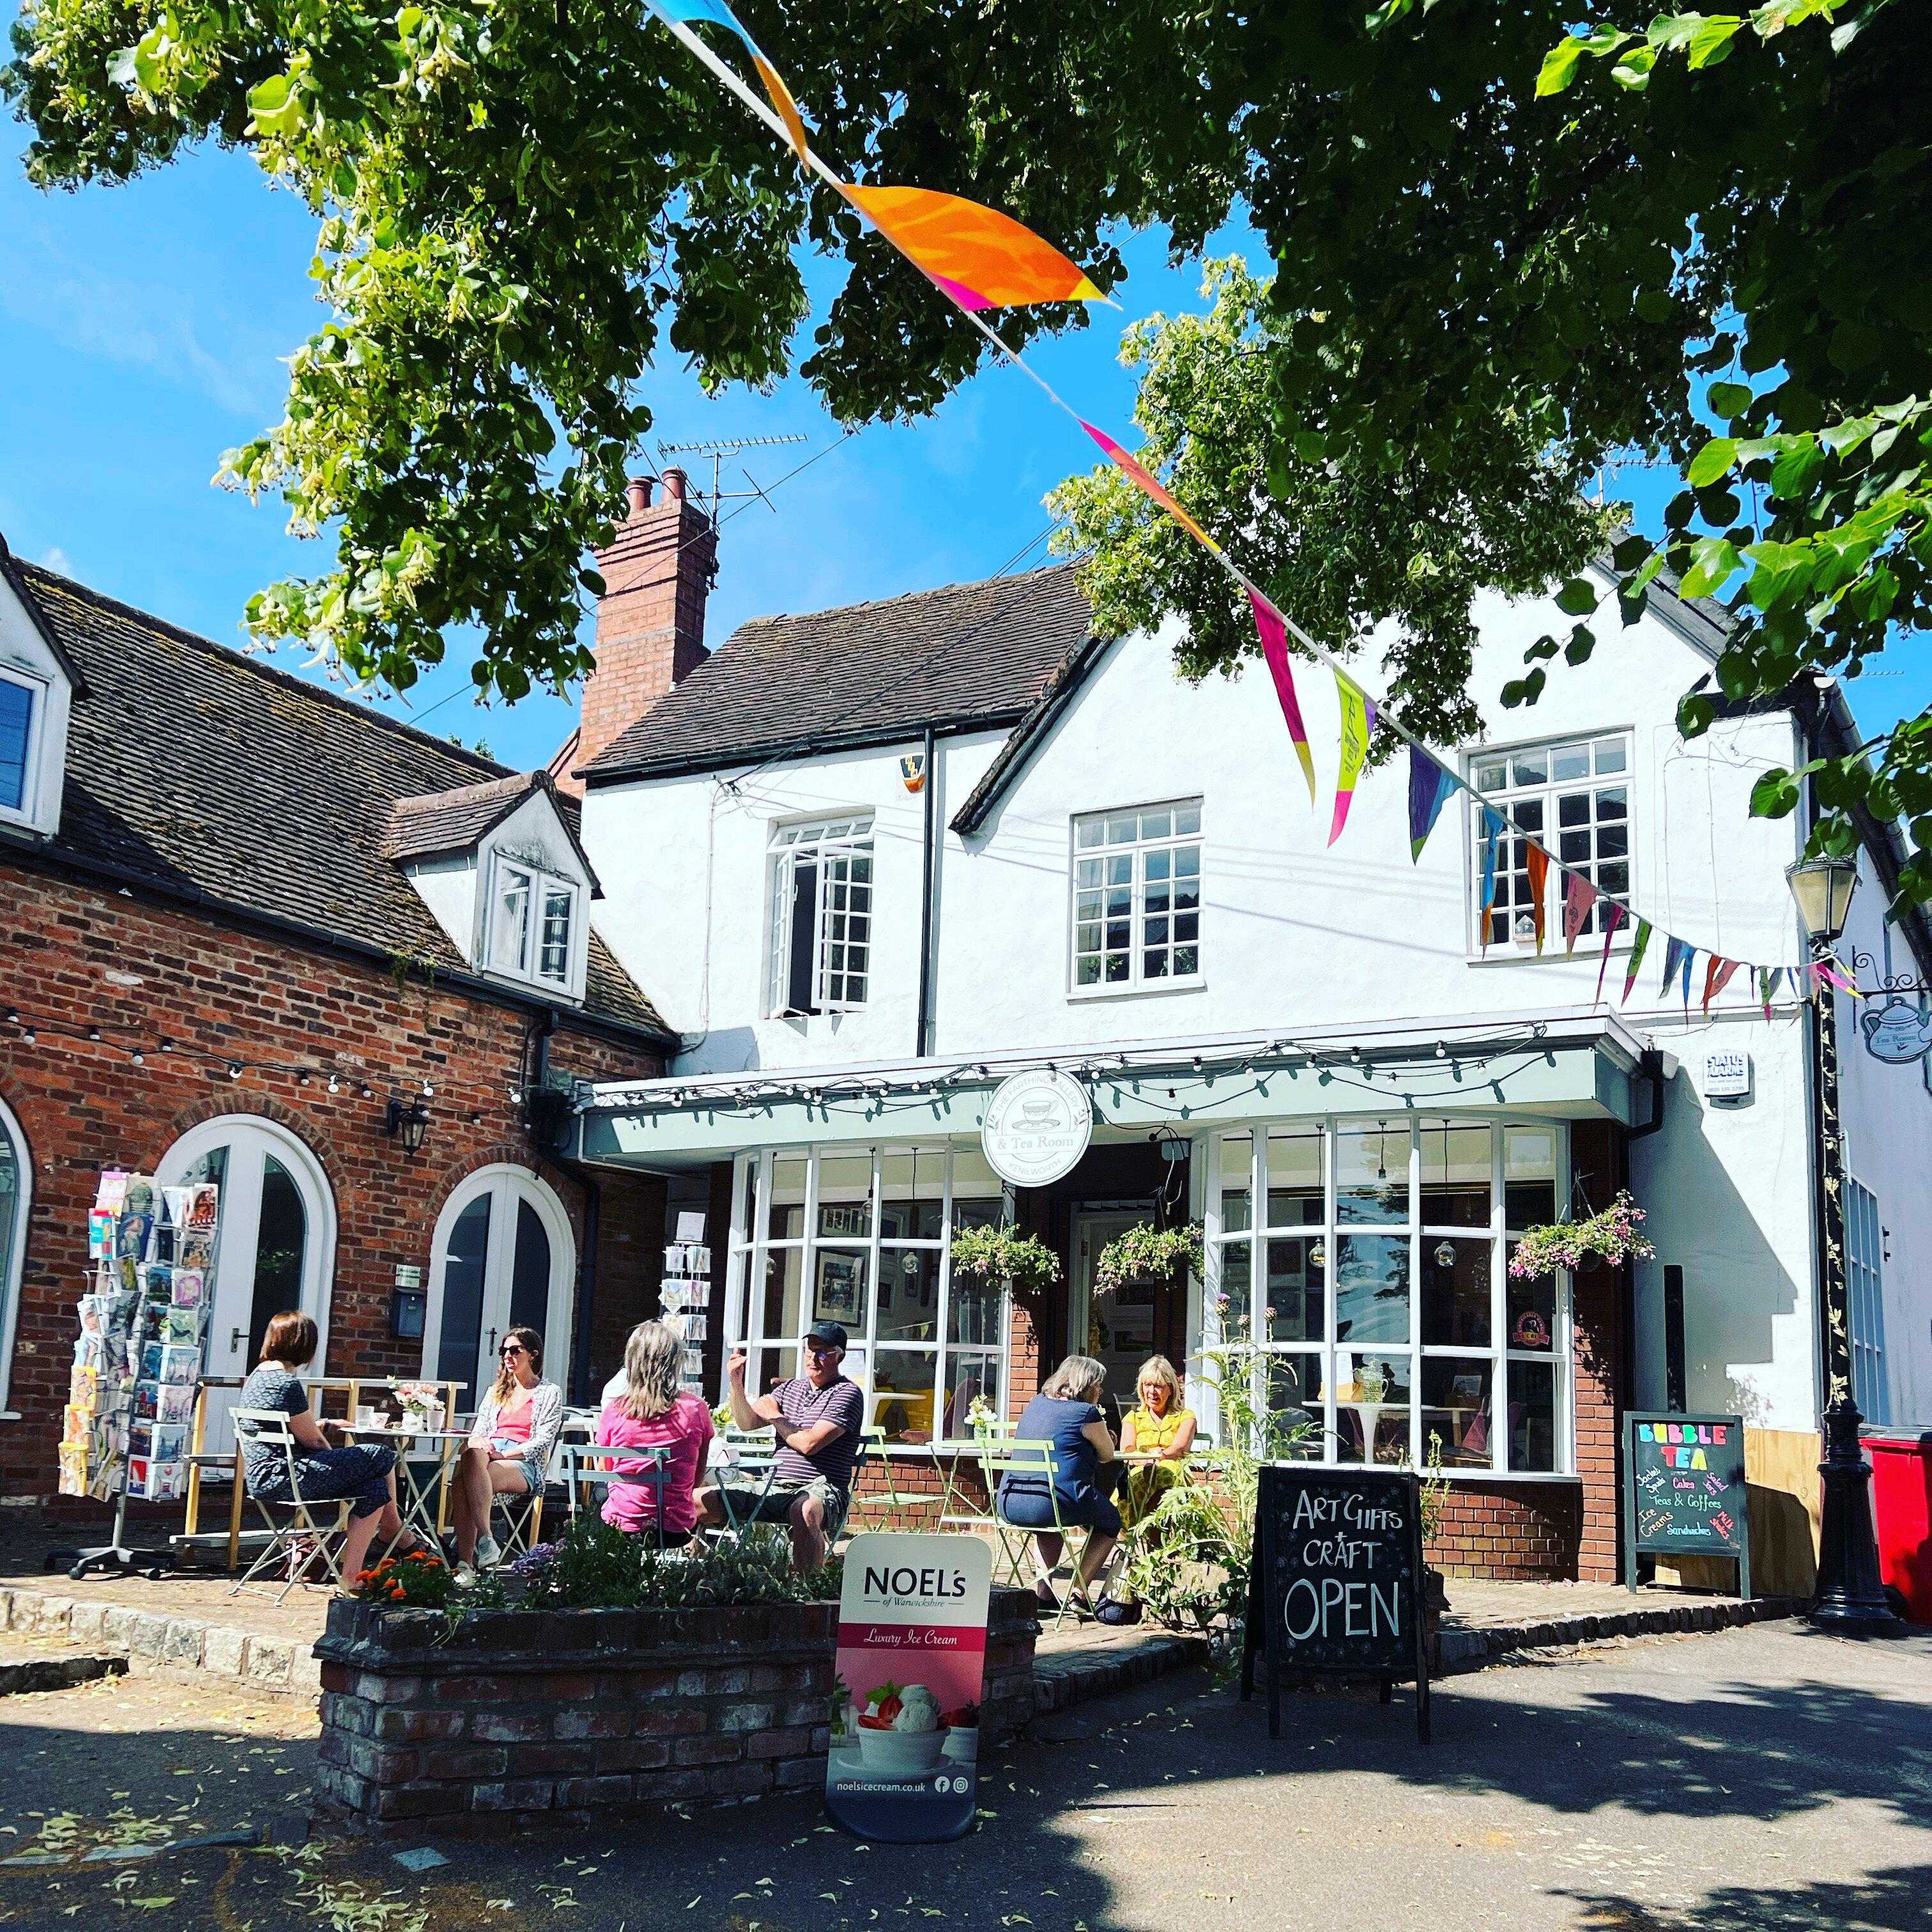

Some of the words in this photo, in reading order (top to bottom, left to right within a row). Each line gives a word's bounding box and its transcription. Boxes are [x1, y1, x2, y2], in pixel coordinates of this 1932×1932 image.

[1874, 1036, 1890, 1044] Tea
[996, 1095, 1009, 1112] THE
[1008, 1075, 1050, 1096] FARTHING
[997, 1138, 1007, 1150] &
[1011, 1137, 1032, 1149] Tea
[1038, 1136, 1073, 1147] Room
[1008, 1158, 1062, 1176] KENILWORTH
[1638, 1423, 1727, 1445] BUBBLE
[1661, 1446, 1708, 1471] TEA
[1648, 1494, 1672, 1506] Teas
[1674, 1492, 1684, 1506] &
[1687, 1494, 1722, 1512] Coffees
[1638, 1508, 1657, 1523] Ice
[1639, 1510, 1674, 1538] Creams
[1666, 1522, 1712, 1537] Sandwiches
[1303, 1539, 1382, 1569] CRAFT
[883, 1597, 893, 1607] of
[894, 1597, 945, 1607] Warwickshire
[1284, 1578, 1400, 1640] OPEN
[864, 1627, 901, 1647] Luxury
[903, 1629, 921, 1644] Ice
[924, 1629, 957, 1645] Cream
[836, 1781, 926, 1793] noelsicecream.co.uk
